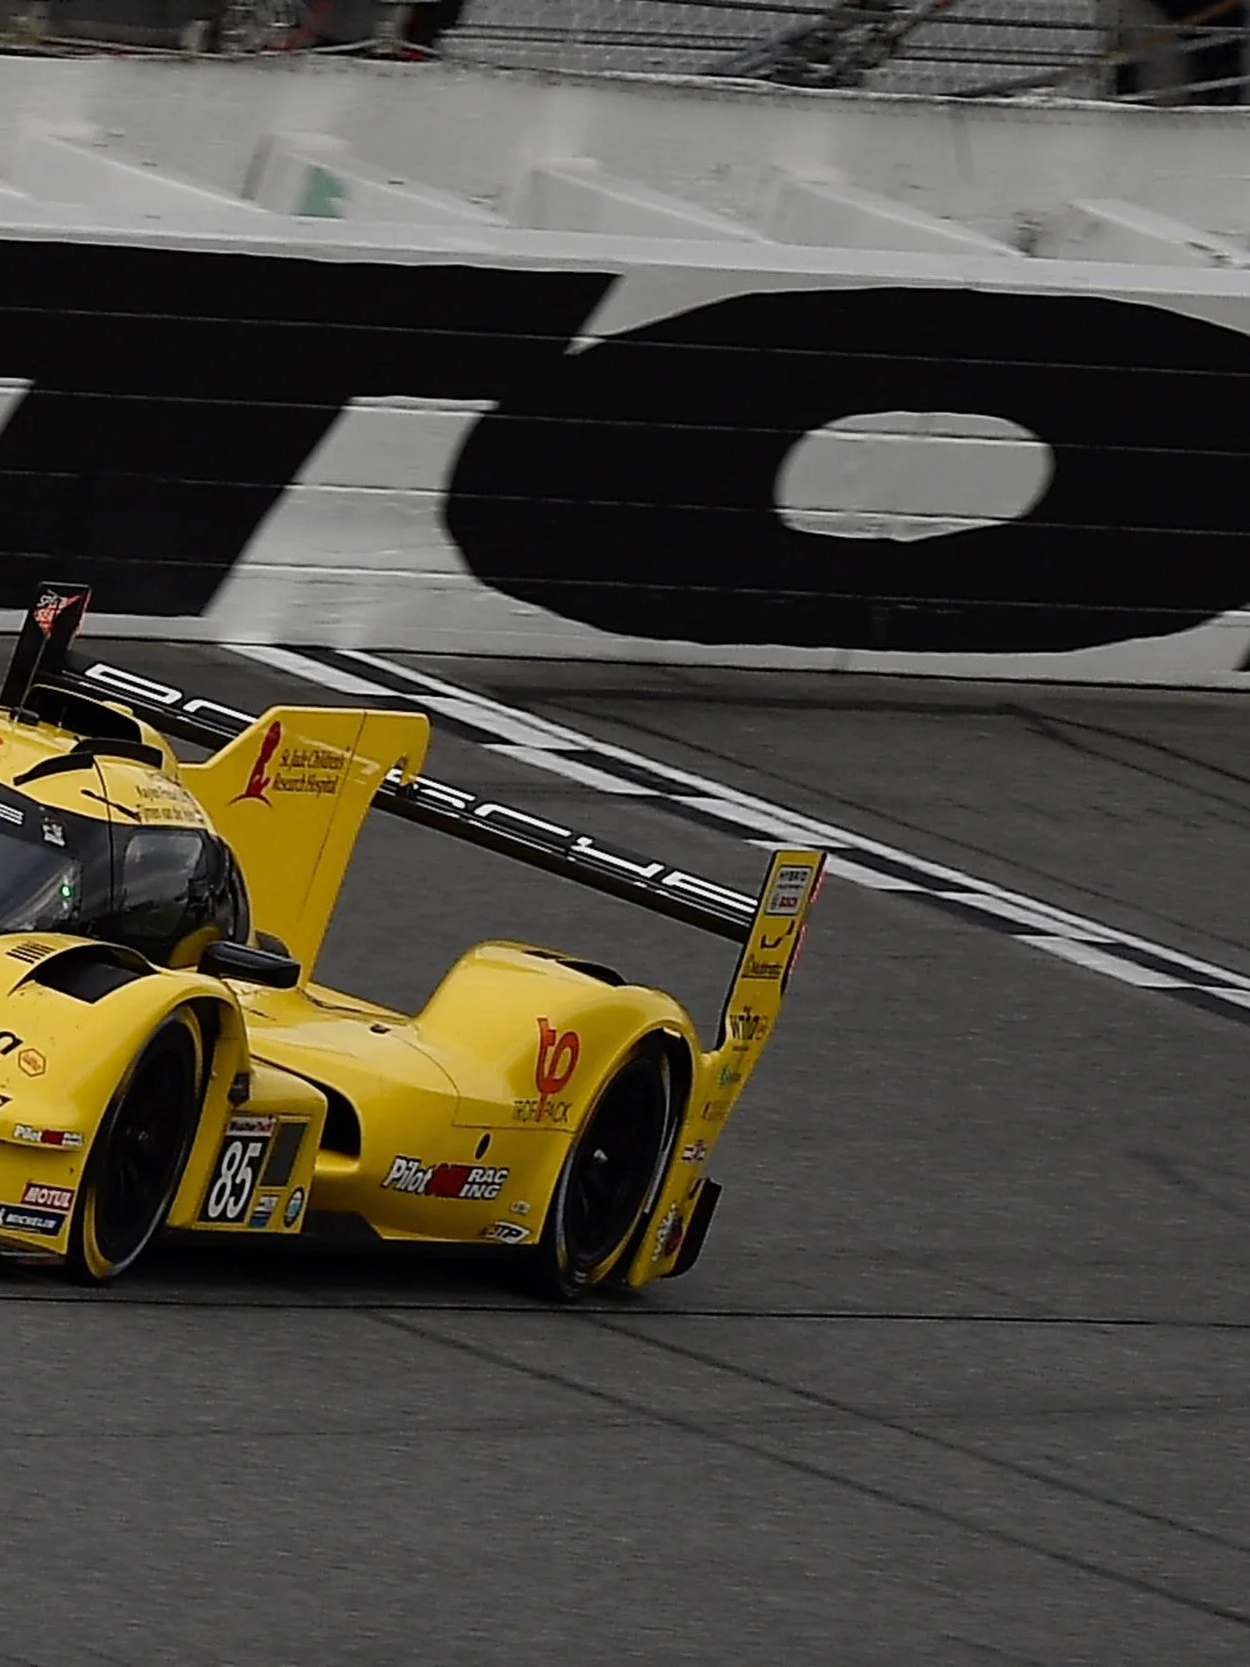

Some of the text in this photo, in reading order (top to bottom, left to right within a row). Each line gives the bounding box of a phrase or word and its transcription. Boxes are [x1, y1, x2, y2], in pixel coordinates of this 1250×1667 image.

[207, 1141, 263, 1219] 85
[382, 1157, 435, 1194] Pilot
[24, 1186, 72, 1208] MOTUL
[5, 1213, 58, 1229] MICHELIN
